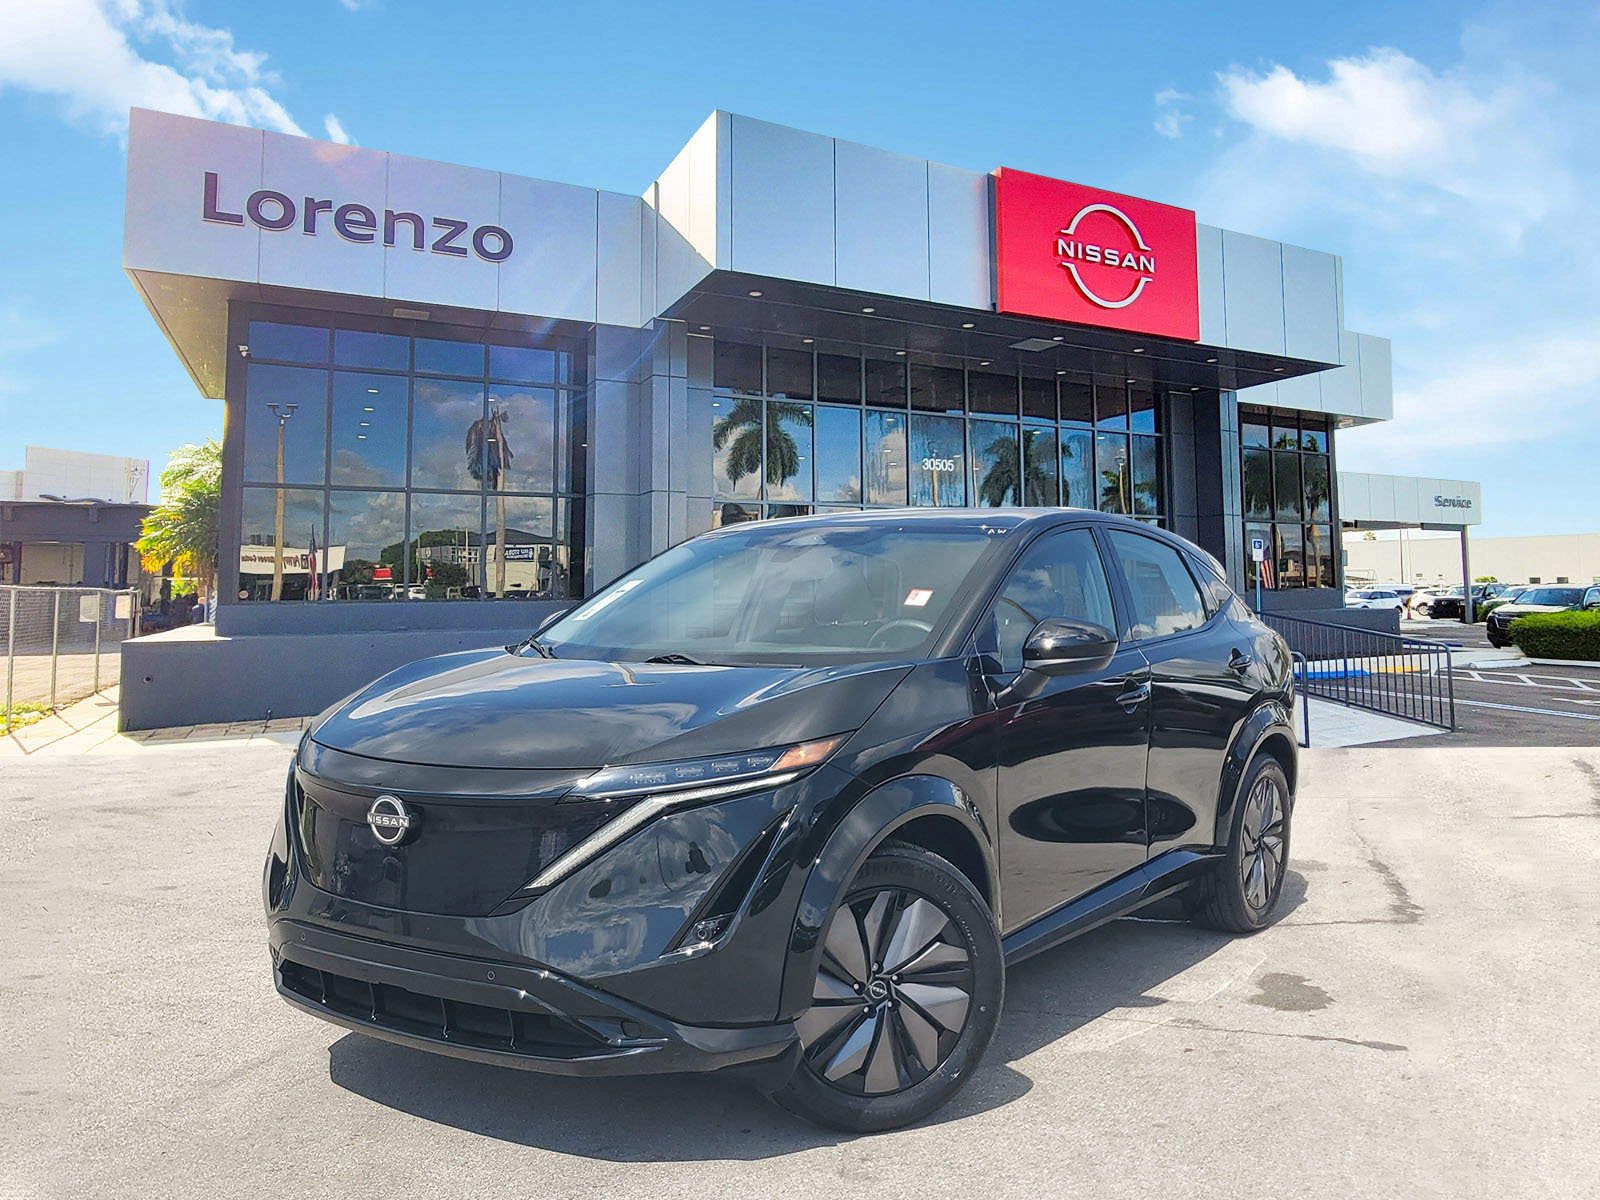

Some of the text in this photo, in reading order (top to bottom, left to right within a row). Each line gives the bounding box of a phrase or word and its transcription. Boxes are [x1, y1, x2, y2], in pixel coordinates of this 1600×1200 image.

[202, 171, 514, 263] Lorenzo
[1057, 238, 1155, 273] NISSAN
[922, 458, 955, 472] 30505
[1434, 495, 1472, 509] Service
[367, 813, 409, 828] NISSAN
